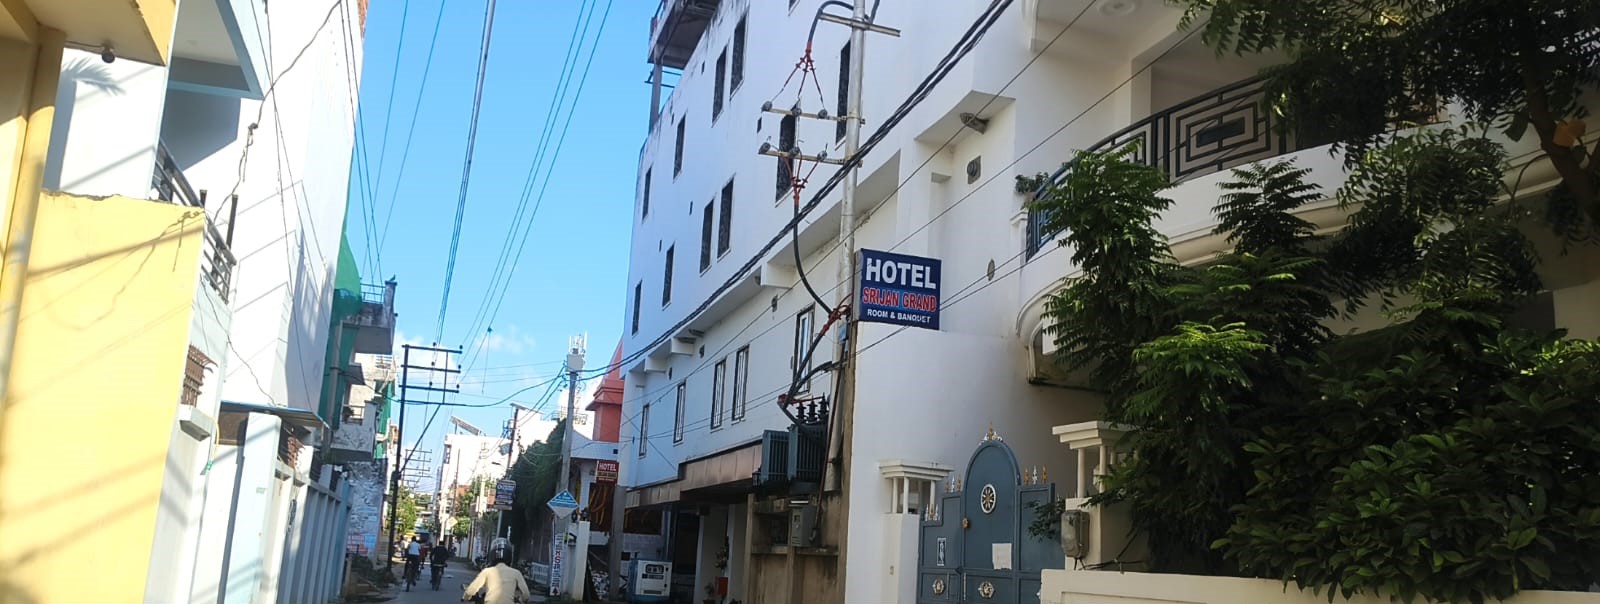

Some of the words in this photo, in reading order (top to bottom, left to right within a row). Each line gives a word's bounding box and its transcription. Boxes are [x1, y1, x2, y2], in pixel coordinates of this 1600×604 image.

[866, 258, 936, 289] HOTEL
[863, 287, 899, 306] SRIJAN
[902, 292, 937, 312] GRAND
[867, 309, 889, 318] ROOM
[897, 313, 931, 323] BANQUET
[599, 463, 617, 471] HOTEL
